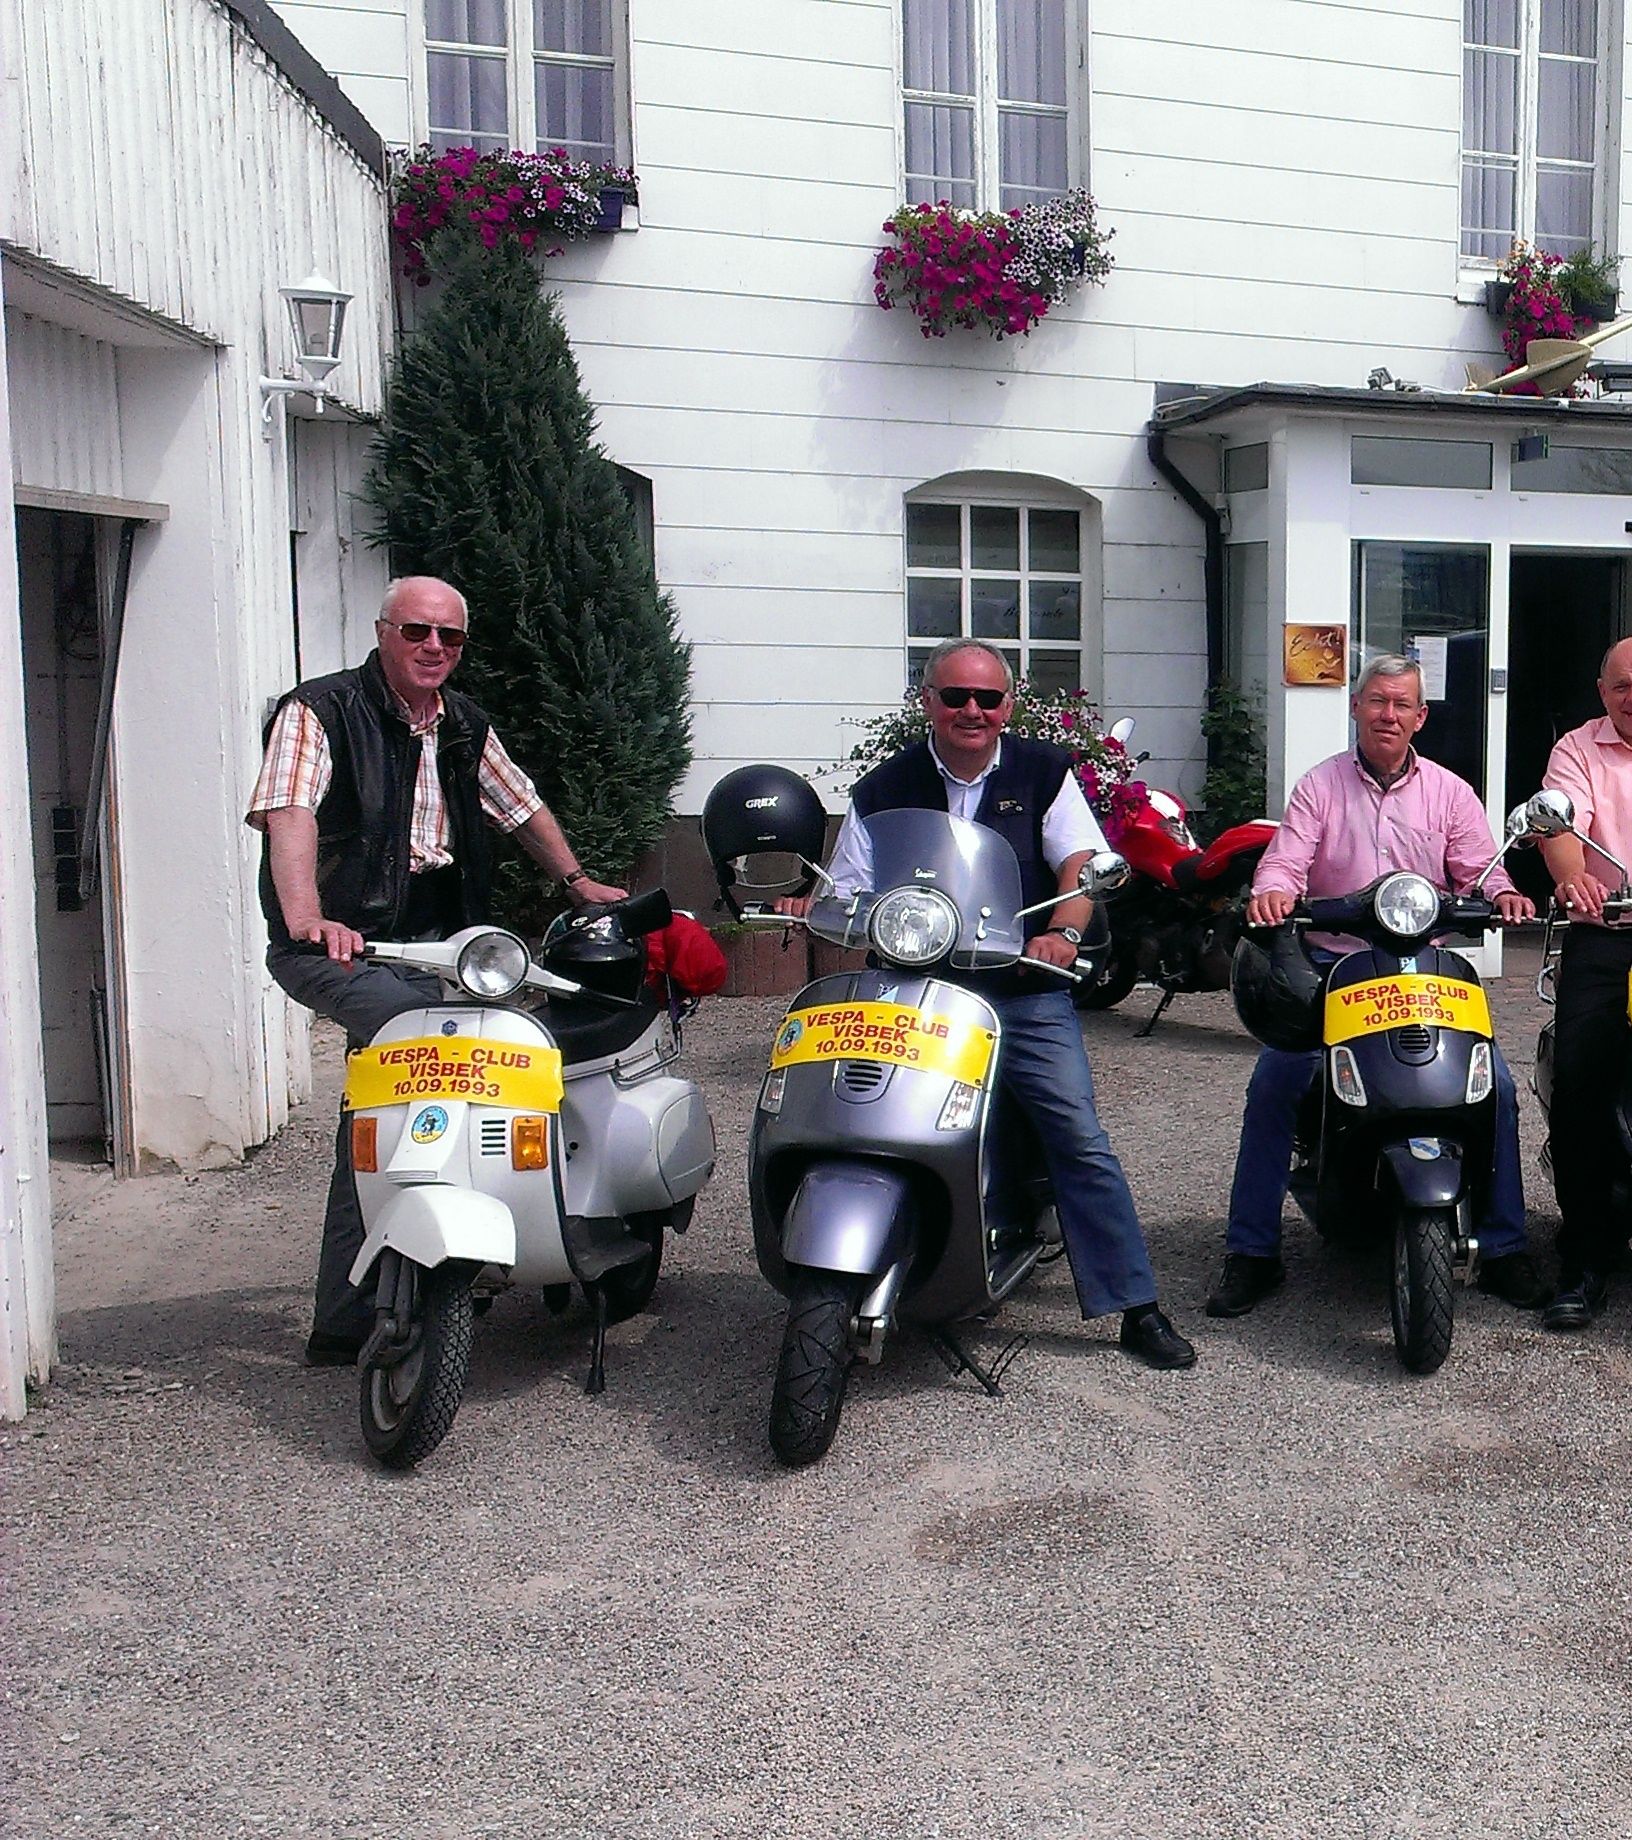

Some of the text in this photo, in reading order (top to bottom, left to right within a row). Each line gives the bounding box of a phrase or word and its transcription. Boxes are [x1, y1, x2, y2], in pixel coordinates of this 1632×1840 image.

[745, 796, 779, 809] GREX
[1341, 983, 1402, 1007] VESPA
[1425, 982, 1469, 1001] CLUB
[1374, 994, 1442, 1011] VISBEK
[806, 1010, 865, 1028] VESPA
[894, 1014, 950, 1039] CLUB
[1362, 1007, 1455, 1026] 10.09.1993
[833, 1024, 911, 1044] VISBEK
[378, 1046, 440, 1066] VESPA
[470, 1048, 532, 1069] CLUB
[815, 1039, 921, 1062] 10.09.1993
[408, 1063, 488, 1080] VISBEK
[393, 1079, 501, 1098] 10.09.1993
